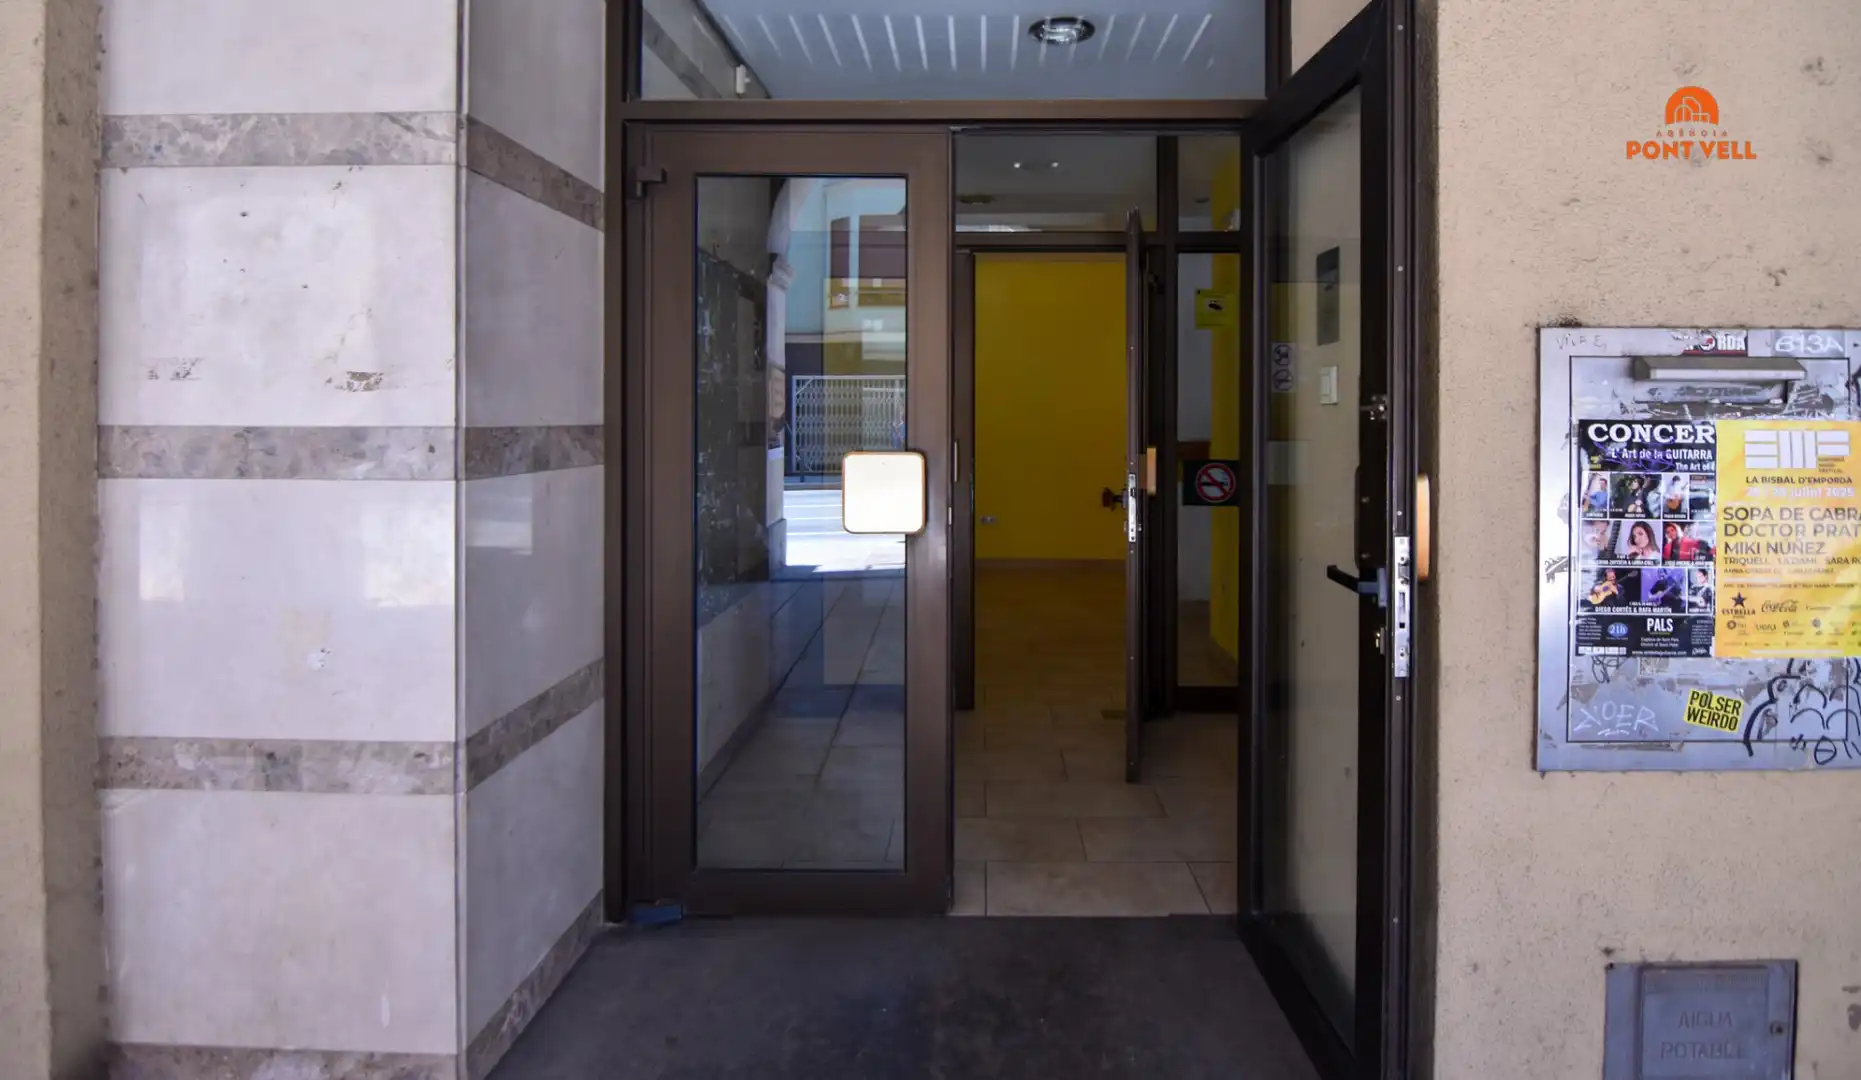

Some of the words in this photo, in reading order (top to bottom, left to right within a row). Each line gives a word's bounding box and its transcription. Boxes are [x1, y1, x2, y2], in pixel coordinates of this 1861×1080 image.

[1587, 423, 1716, 444] CONCER
[1665, 449, 1713, 460] GUITARRA
[1675, 462, 1689, 471] The
[1690, 462, 1701, 471] Art
[1745, 476, 1759, 485] LA
[1761, 476, 1795, 485] BISBAL
[1723, 506, 1774, 521] SOPA
[1779, 506, 1804, 521] DE
[1809, 506, 1861, 521] CABR
[1724, 523, 1806, 537] DOCTOR
[1724, 542, 1761, 555] MIKI
[1824, 557, 1850, 565] SARA
[1647, 618, 1674, 632] PALS
[1687, 707, 1739, 731] WEIRDO
